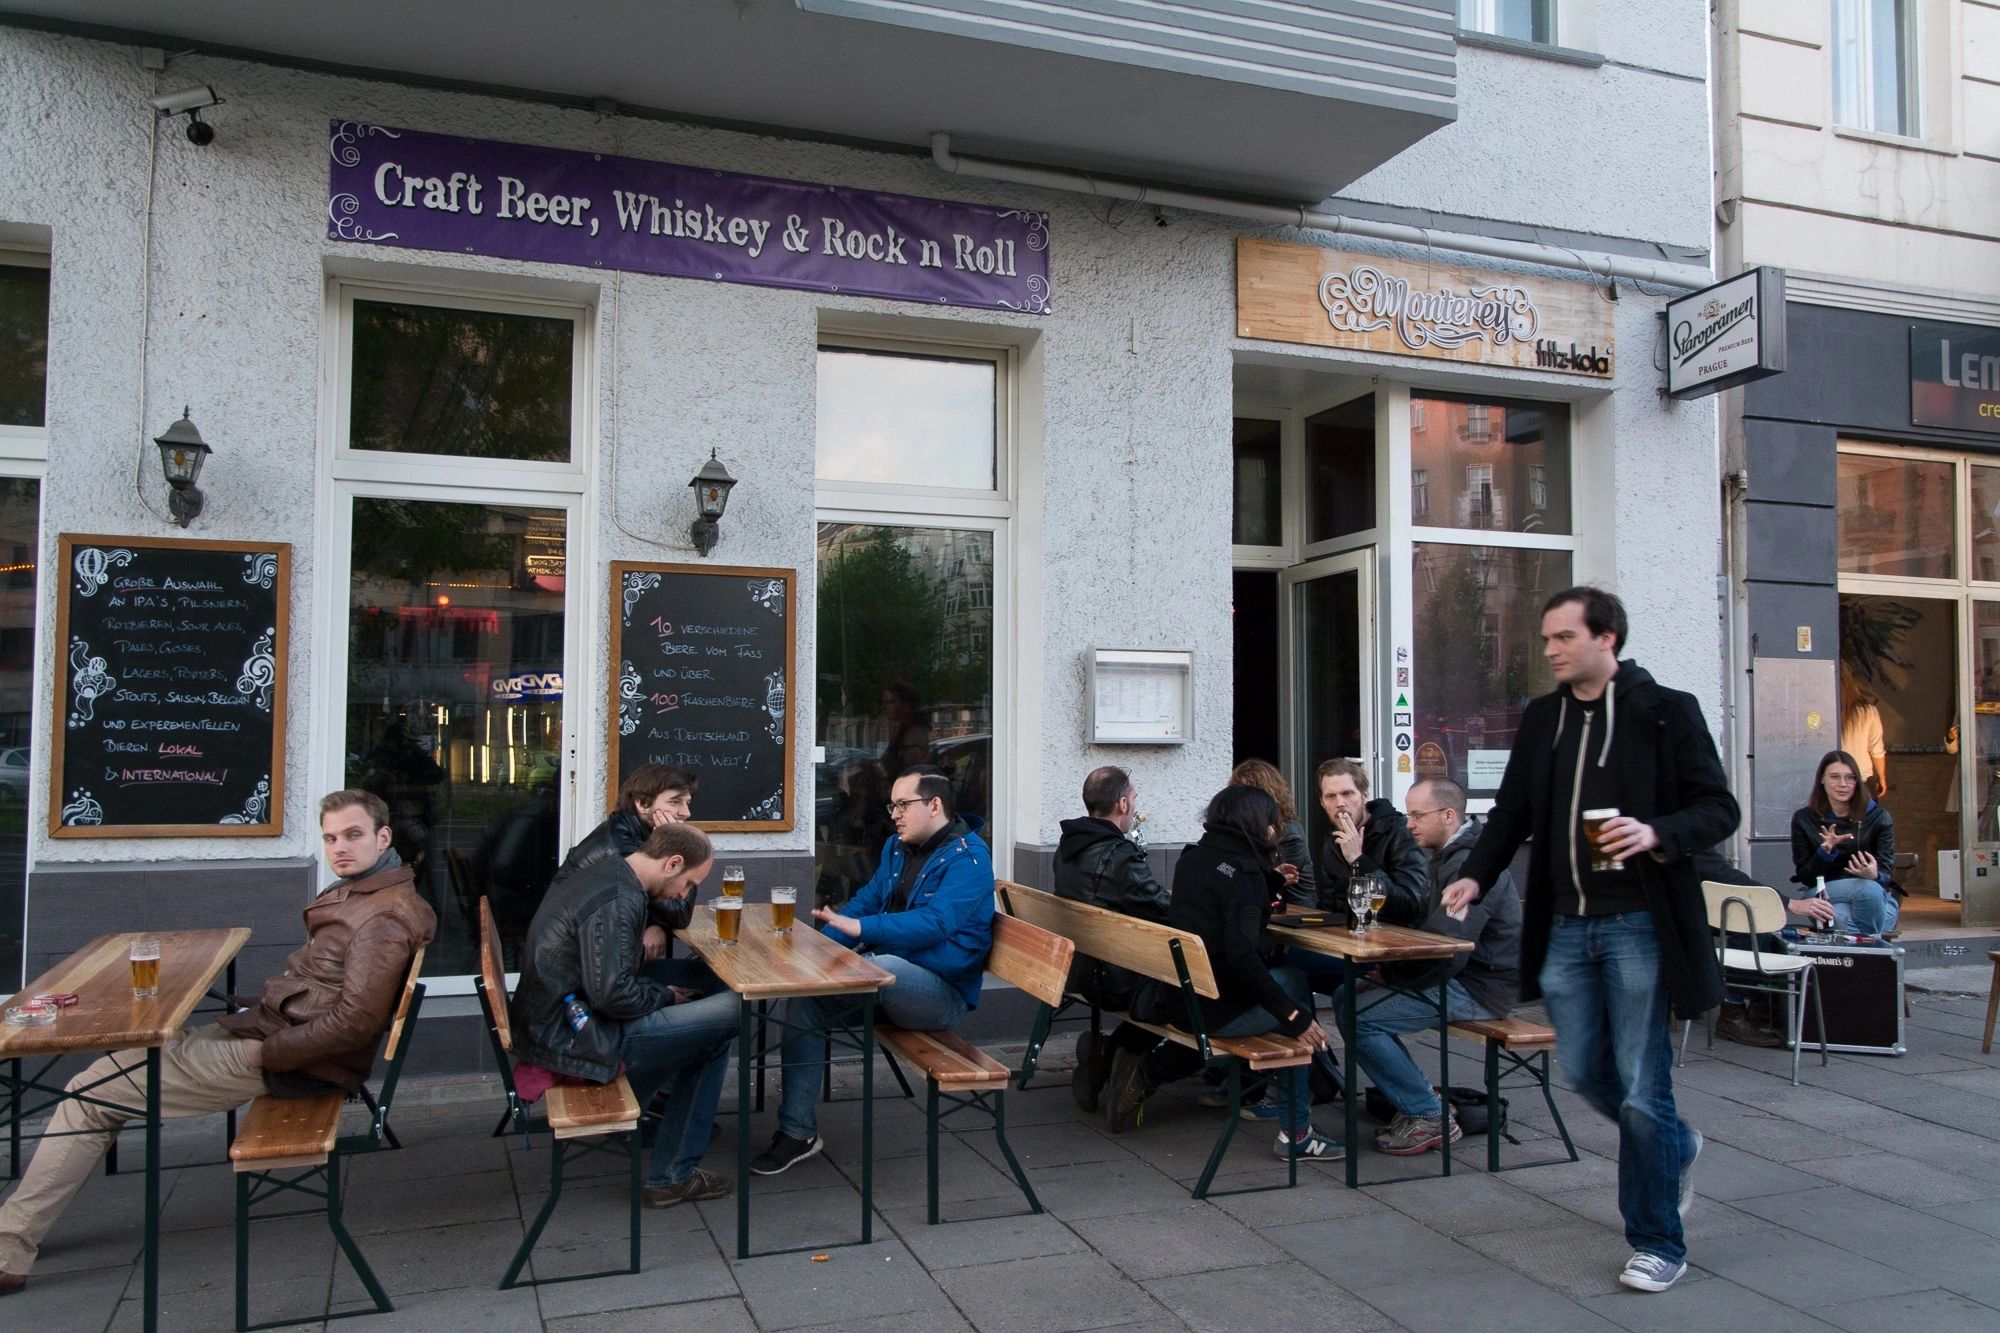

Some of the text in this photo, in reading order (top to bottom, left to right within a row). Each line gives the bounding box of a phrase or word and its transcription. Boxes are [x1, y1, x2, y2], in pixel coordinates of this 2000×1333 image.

[374, 161, 1017, 277] Craft Beer, Whiskey & Rock n Roll
[1352, 267, 1515, 348] Monterey
[1673, 295, 1755, 360] Staropramen
[1535, 338, 1609, 374] fritz-kola
[1698, 359, 1728, 376] PRAGUE
[163, 577, 224, 590] AUSWAHL
[108, 596, 126, 607] AN
[177, 620, 210, 632] SOUR
[649, 615, 760, 636] 10 VERSCHIEDENE
[660, 641, 762, 659] BIERE VOM FASS
[653, 665, 715, 680] UND ÜBER
[113, 689, 161, 705] STOUTS,
[208, 692, 250, 705] BELGIAN
[649, 692, 756, 709] 100 FLASCHENBIERE
[103, 720, 126, 730] UND
[648, 727, 750, 742] AUS DEUTSCHLAND
[158, 742, 204, 755] LOKAL
[648, 753, 673, 765] UND
[676, 752, 704, 766] DER
[104, 766, 228, 786] & INTERNATIONAL!
[1817, 956, 1842, 966] DANIEL'S
